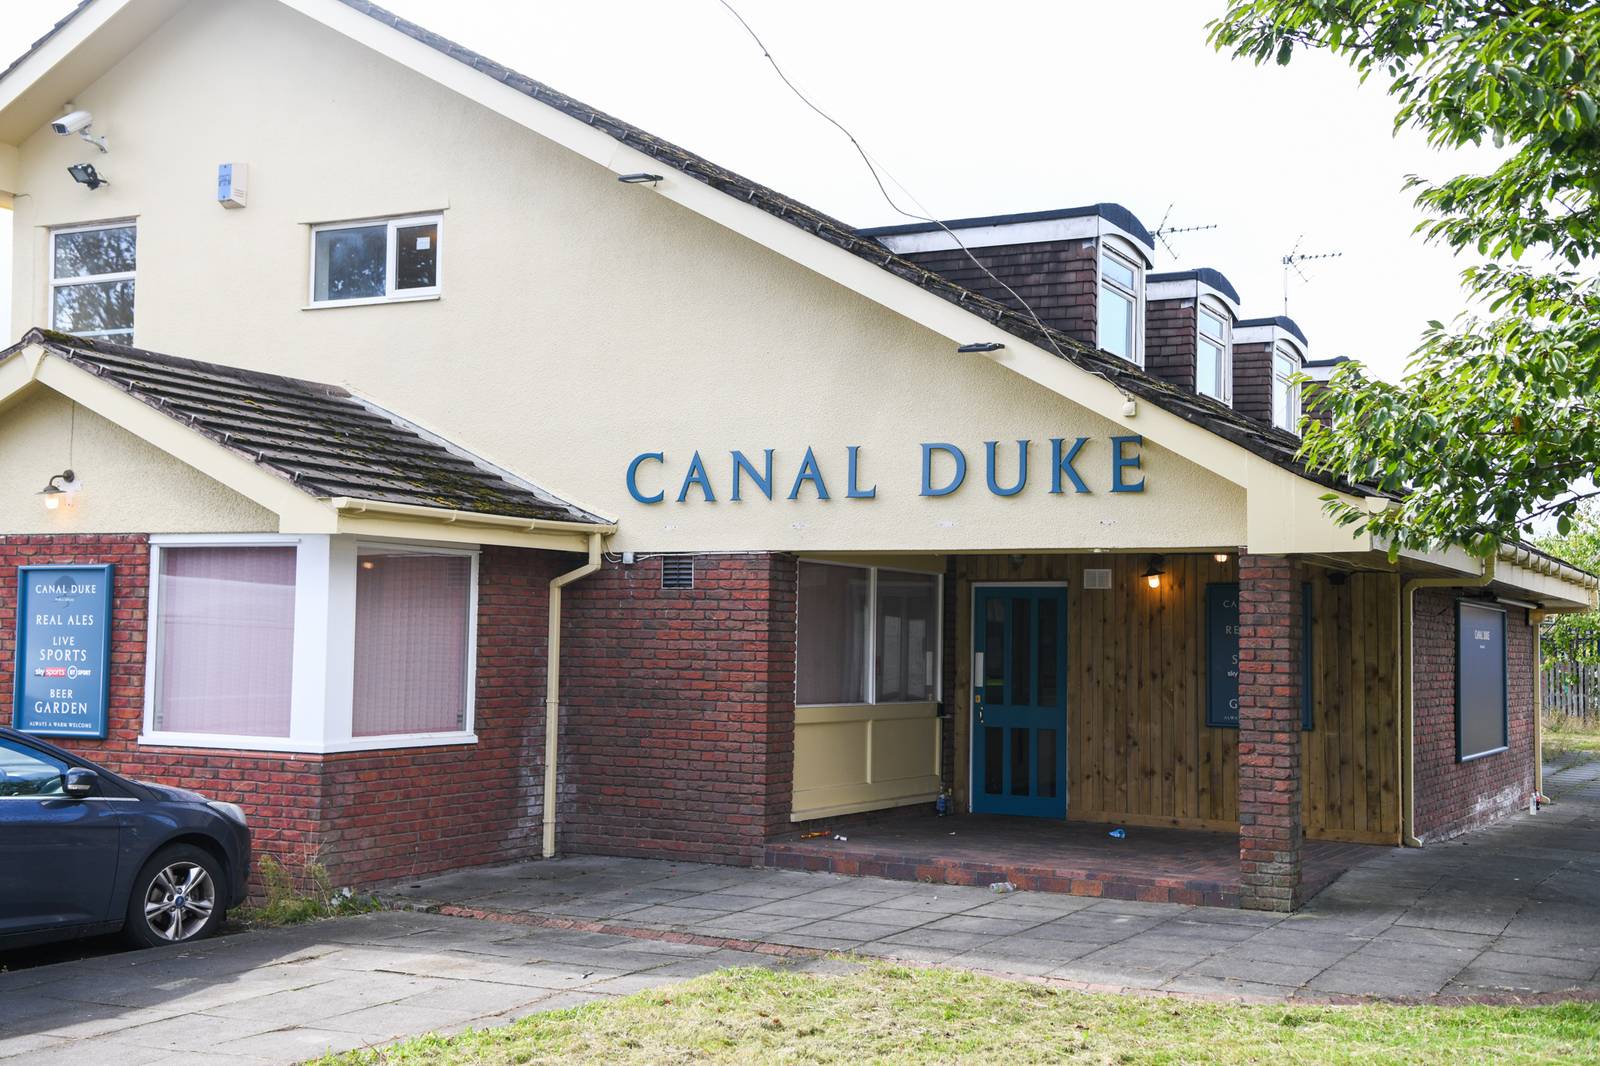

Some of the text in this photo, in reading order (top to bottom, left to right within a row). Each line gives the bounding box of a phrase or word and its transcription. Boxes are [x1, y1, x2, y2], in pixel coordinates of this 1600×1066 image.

[626, 434, 1146, 504] CANAL DUKE
[35, 584, 97, 594] CANAL DUKE
[1223, 600, 1238, 608] CA
[36, 614, 94, 626] REAL ALES
[1225, 625, 1240, 635] RE
[53, 636, 75, 646] LIVE
[40, 649, 87, 662] SPORTS
[35, 667, 46, 677] sky
[50, 689, 73, 699] BEER
[34, 701, 88, 715] GARDEN
